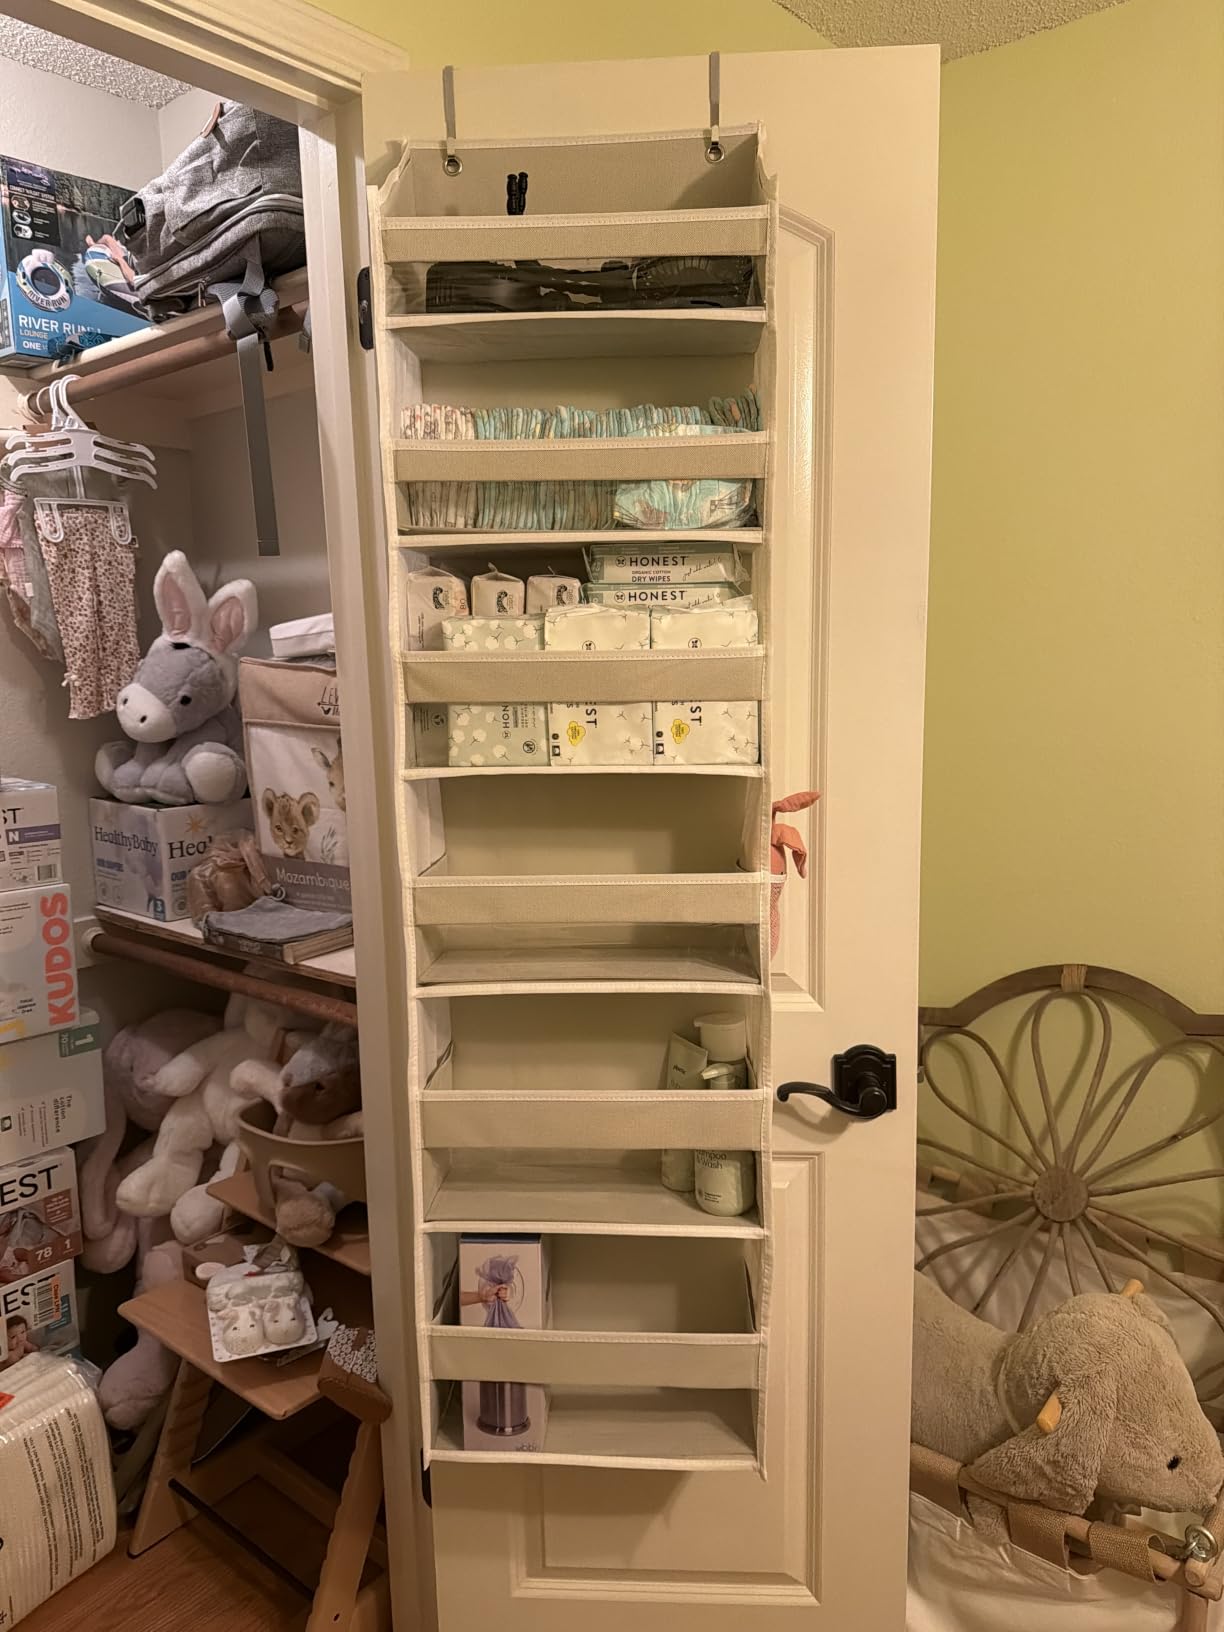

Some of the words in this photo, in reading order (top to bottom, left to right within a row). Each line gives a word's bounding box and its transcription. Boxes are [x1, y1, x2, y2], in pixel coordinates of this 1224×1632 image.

[28, 290, 51, 307] RIVER
[18, 315, 59, 334] RIVER
[20, 329, 48, 339] LOUNGE
[22, 340, 41, 350] ONE
[629, 556, 687, 567] HONEST
[628, 591, 686, 601] HONEST
[585, 702, 597, 726] ST
[8, 831, 20, 843] N
[94, 826, 158, 857] HealthyBaby
[276, 867, 350, 889] Mozambique
[40, 892, 76, 1026] KUDOS
[0, 1164, 58, 1206] EST
[35, 1247, 52, 1260] 78
